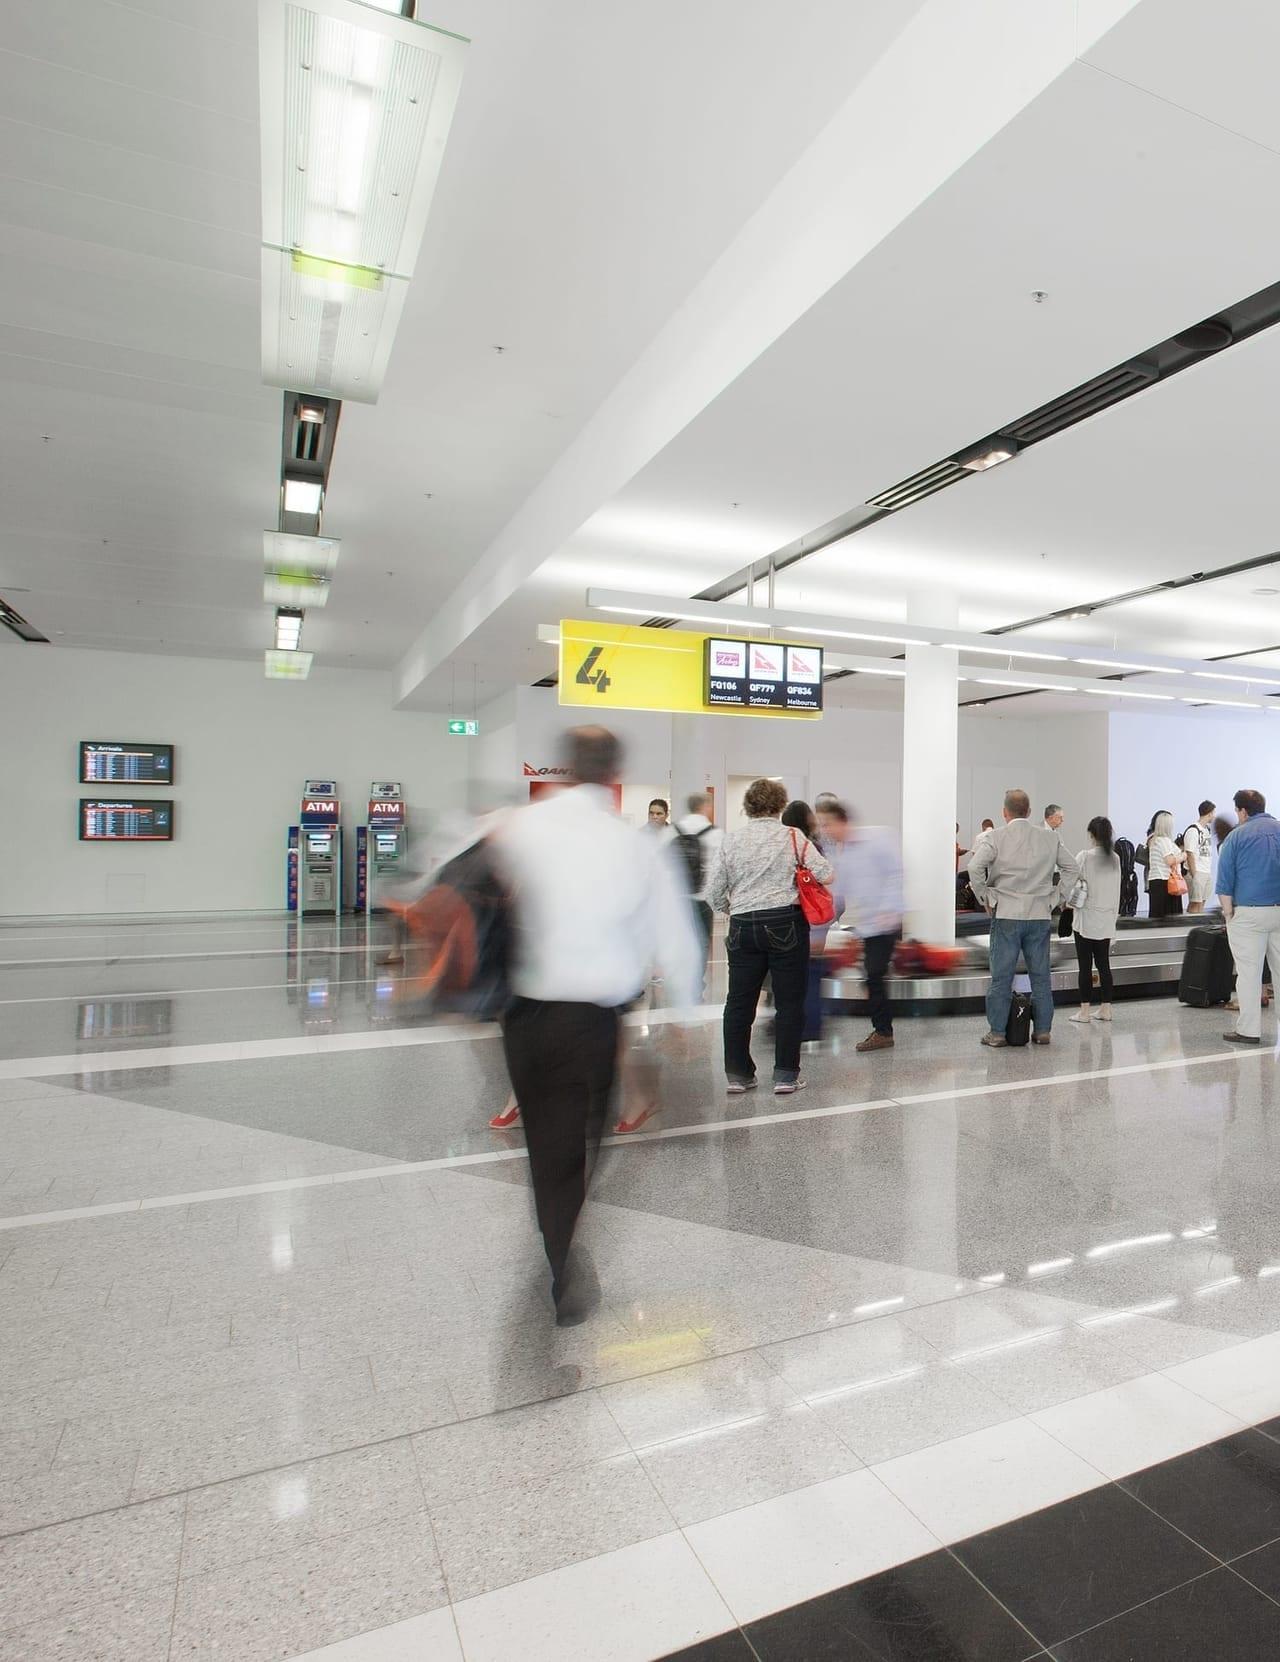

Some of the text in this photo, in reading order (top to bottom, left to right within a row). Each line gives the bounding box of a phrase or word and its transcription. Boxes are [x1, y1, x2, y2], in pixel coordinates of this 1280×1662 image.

[576, 646, 611, 692] 4
[711, 681, 737, 690] FQ106
[750, 684, 776, 693] QF779
[787, 686, 813, 695] QF834
[711, 694, 742, 702] Newcastle
[750, 696, 771, 705] Sydney
[787, 698, 818, 707] Melbourne
[305, 802, 335, 812] ATM
[373, 803, 400, 813] ATM
